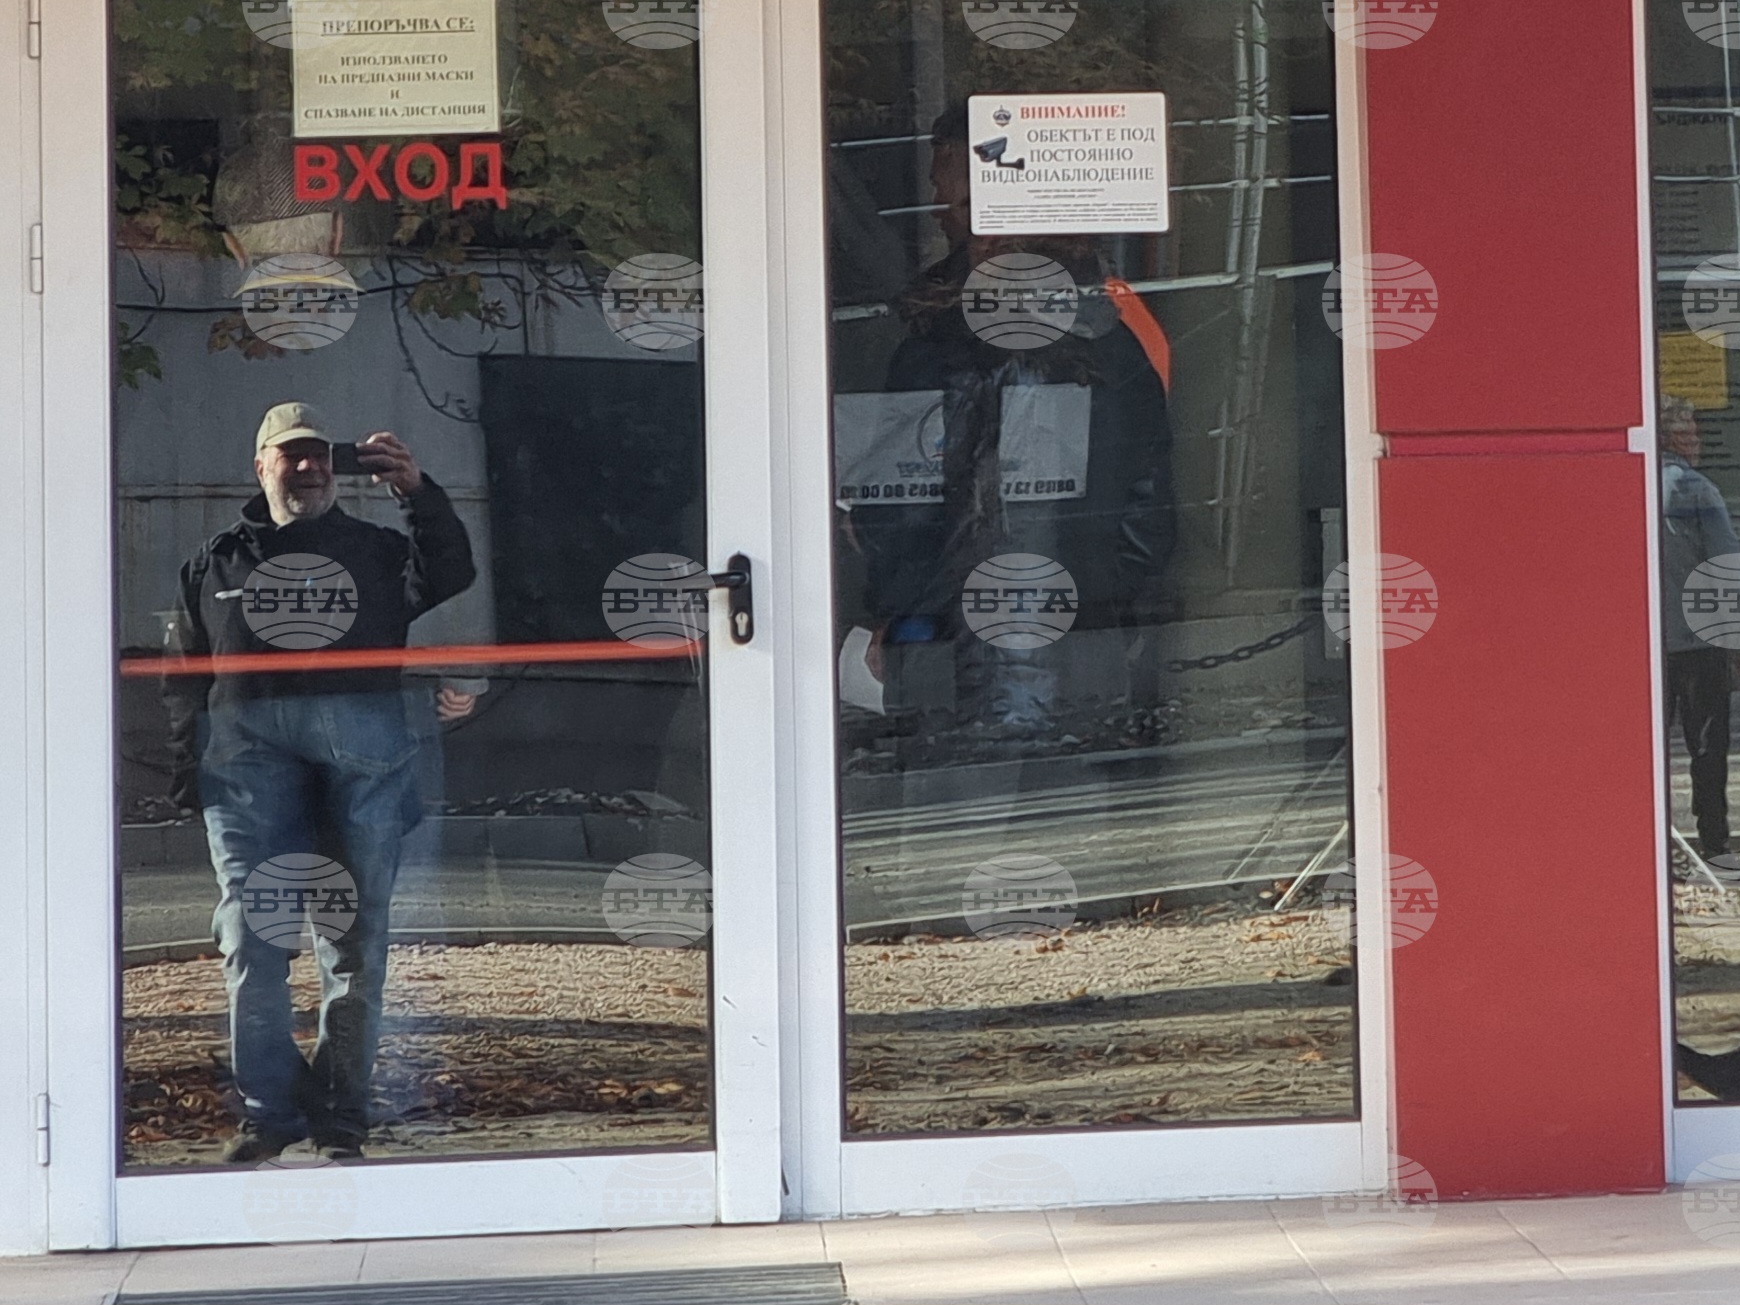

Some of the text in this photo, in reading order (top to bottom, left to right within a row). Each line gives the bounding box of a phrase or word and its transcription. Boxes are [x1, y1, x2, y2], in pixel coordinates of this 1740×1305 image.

[322, 16, 475, 34] ПРЕПОРЪЧВА СЕ:
[424, 70, 474, 82] МАСКИ
[304, 104, 486, 119] СПАЗВАНЕ НА ДИСТАНЦИЯ
[1020, 105, 1126, 120] ВНИМАНИЕ!
[1027, 127, 1155, 143] ОБЕКТЪТ Е ПОД
[1030, 147, 1133, 163] ПОСТОЯННО
[294, 142, 509, 210] ВХОД
[981, 167, 1154, 184] ВИДЕОНАБЛЮДЕНИЕ
